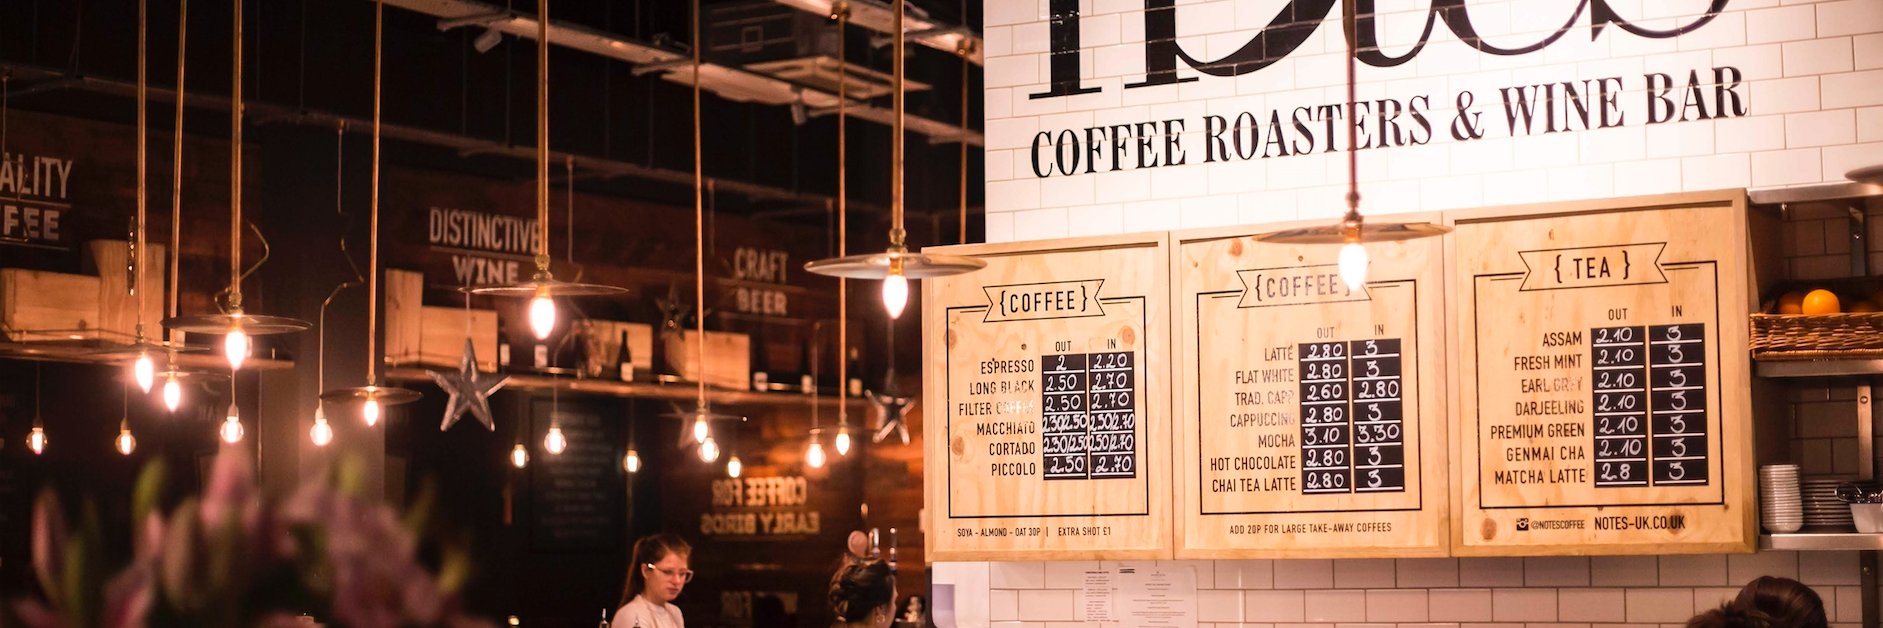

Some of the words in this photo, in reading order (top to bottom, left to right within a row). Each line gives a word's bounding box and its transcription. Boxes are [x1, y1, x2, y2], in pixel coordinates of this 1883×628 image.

[1030, 118, 1187, 179] COFFEE
[1202, 94, 1433, 164] ROASTERS
[1450, 90, 1485, 142] &
[1498, 76, 1626, 138] WINE
[1643, 65, 1749, 126] BAR
[429, 206, 540, 255] DISTINCTIVE
[452, 254, 520, 286] WINE
[734, 246, 789, 284] CRAFT
[1573, 256, 1611, 280] TEA
[737, 287, 788, 316] BEER
[1608, 308, 1628, 321] OUT
[1671, 305, 1682, 317] IN
[1317, 326, 1335, 338] OUT
[1374, 324, 1384, 335] IN
[1542, 331, 1582, 347] ASSAM
[1596, 327, 1632, 344] 2.10
[1666, 325, 1682, 341] 3
[1055, 340, 1072, 352] OUT
[1107, 338, 1117, 350] IN
[1307, 343, 1343, 359] 2.80
[1365, 339, 1378, 356] 3
[981, 359, 1034, 375] ESPRESSO
[1055, 355, 1067, 371] 2
[1093, 353, 1128, 369] 2.20
[1514, 355, 1551, 371] FRESH
[1554, 353, 1583, 369] MINT
[1597, 348, 1634, 365] 2.10
[1668, 344, 1684, 363] 3
[969, 381, 997, 396] LONG
[1001, 379, 1035, 394] BLACK
[1045, 373, 1077, 392] 2.50
[1091, 372, 1127, 391] 2.70
[1235, 369, 1259, 384] FLAT
[1261, 368, 1294, 383] WHITE
[1307, 363, 1342, 380] 2.80
[1366, 360, 1380, 377] 3
[1521, 378, 1551, 393] EARL
[1598, 371, 1635, 389] 2.10
[1669, 368, 1686, 387] 3
[959, 402, 992, 416] FILTER
[1045, 394, 1081, 412] 2.50
[1091, 392, 1130, 410] 2.70
[1235, 391, 1264, 406] TRAD.
[1358, 380, 1399, 399] 2.80
[1515, 399, 1584, 416] DARJEELING
[1598, 393, 1636, 412] 2.10
[1671, 390, 1687, 410] 3
[1305, 406, 1343, 423] 2.80
[1367, 402, 1382, 421] 3
[977, 420, 1035, 436] MACCHIATO
[1258, 433, 1296, 448] MOCHA
[1304, 427, 1340, 445] 3.10
[1357, 423, 1400, 443] 3.30
[1491, 423, 1544, 440] PREMIUM
[1548, 422, 1585, 438] GREEN
[1598, 415, 1638, 435] 2.10
[1670, 414, 1686, 433] 3
[989, 441, 1036, 456] CORTADO
[1210, 457, 1231, 472] HOT
[1234, 455, 1296, 471] CHOCOLATE
[1305, 448, 1344, 467] 2.80
[1367, 446, 1382, 466] 3
[1506, 446, 1555, 462] GENMAI
[1560, 446, 1585, 460] CHA
[1598, 438, 1642, 457] 2.10
[1671, 437, 1687, 457] 3
[991, 462, 1036, 477] PICCOLO
[1050, 455, 1085, 474] 2.50
[1095, 455, 1132, 473] 2.70
[1494, 469, 1544, 485] MATCHA
[1550, 468, 1586, 484] LATTE
[1668, 461, 1685, 481] 3
[1212, 478, 1237, 493] CHAI
[1240, 478, 1260, 492] TEA
[1264, 477, 1297, 492] LATTE
[1306, 471, 1344, 489] 2.80
[1367, 468, 1382, 488] 3
[957, 528, 973, 537] SOYA
[980, 527, 1008, 537] ALMOND
[1015, 527, 1027, 537] OAT
[1028, 526, 1041, 537] 30P
[1058, 526, 1080, 536] EXTRA
[1082, 526, 1101, 536] SHOT
[1102, 526, 1112, 535] £1
[1230, 525, 1245, 535] ADD
[1247, 524, 1262, 535] 20P
[1264, 524, 1279, 534] FOR
[1281, 523, 1306, 534] LARGE
[1309, 522, 1354, 533] TAKE-AWAY
[1356, 522, 1392, 533] COFFEES
[1531, 519, 1585, 530] @NOTESCOFFEE
[1594, 515, 1686, 531] NOTES-UK.CO.UK
